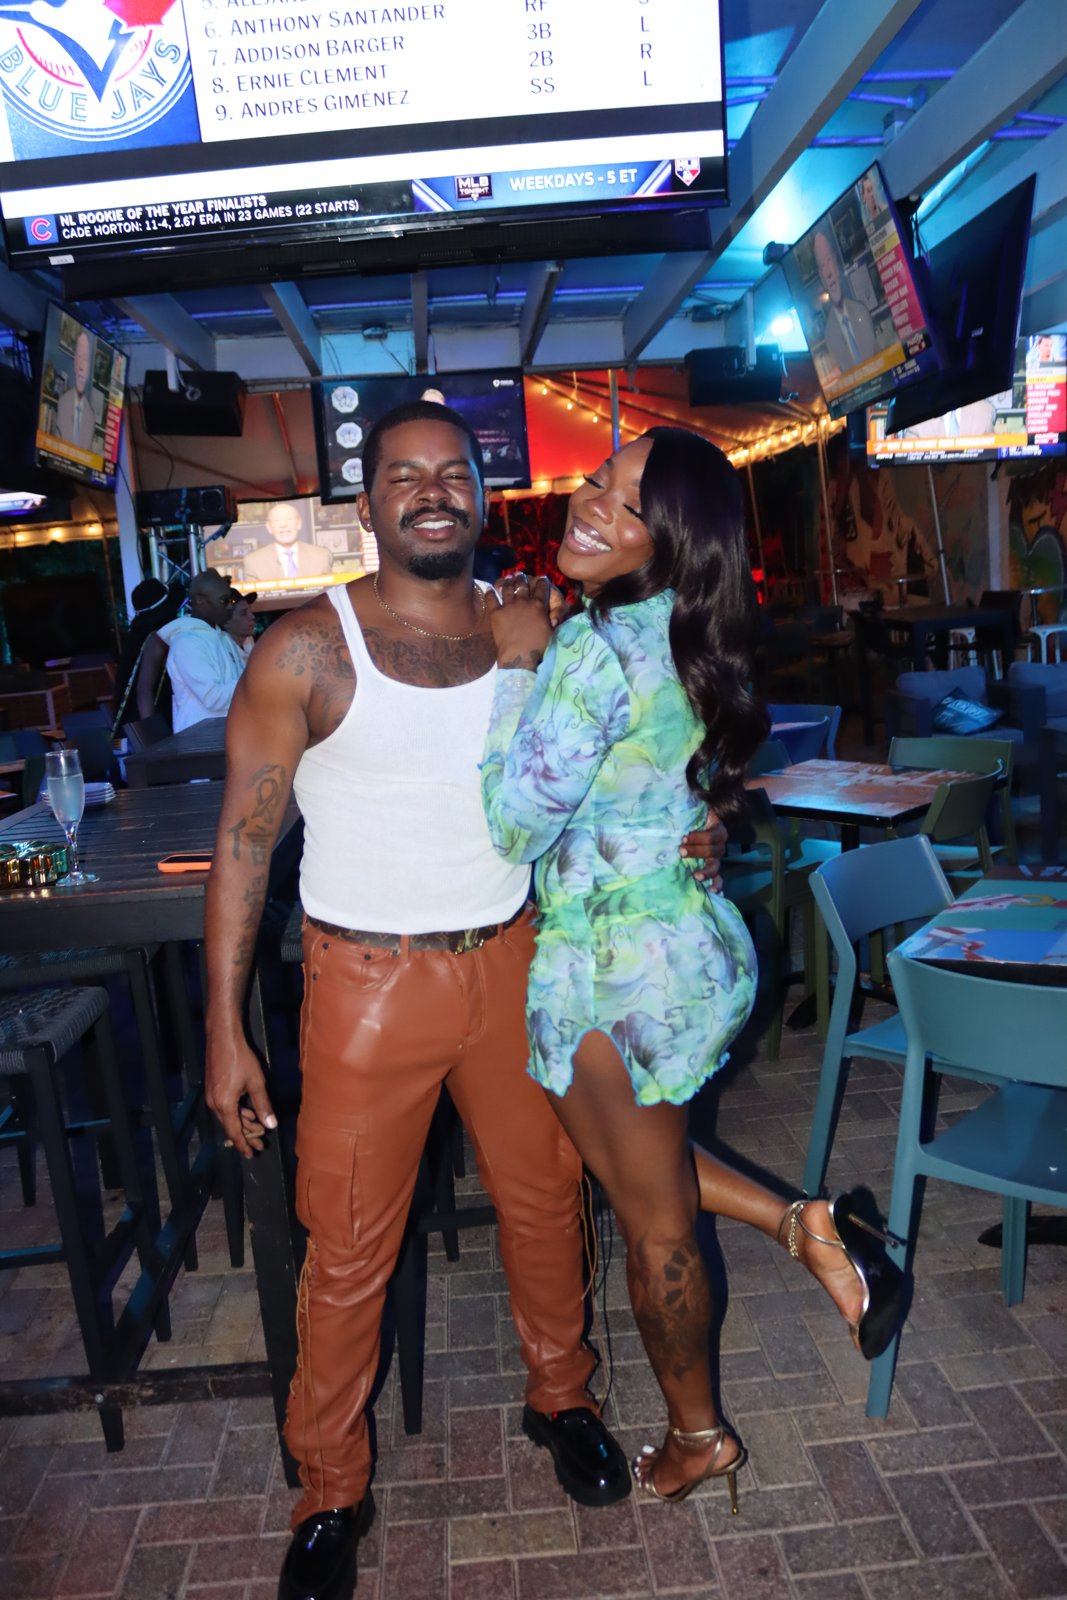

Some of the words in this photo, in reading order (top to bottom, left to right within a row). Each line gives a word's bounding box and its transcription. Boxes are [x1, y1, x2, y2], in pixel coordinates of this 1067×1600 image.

[204, 21, 222, 38] 6.
[231, 14, 322, 36] ANTHONY
[328, 4, 445, 28] SANTANDER
[208, 49, 226, 66] 7.
[234, 42, 320, 64] ADDISON
[326, 35, 404, 56] BARGER
[527, 22, 551, 40] 3B
[641, 16, 650, 32] L
[0, 44, 87, 122] BLUE
[111, 39, 181, 120] JAYS
[212, 77, 229, 94] 8.
[237, 73, 294, 92] ERNIE
[300, 64, 387, 85] CLEMENT
[529, 50, 553, 67] 2B
[641, 43, 652, 59] R
[215, 104, 233, 121] 9.
[241, 96, 318, 119] ANDRÉS
[324, 90, 410, 111] GIMÉNEZ
[531, 77, 555, 94] SS
[643, 70, 653, 86] L
[459, 176, 489, 188] MLB
[509, 171, 594, 192] WEEKDAYS
[606, 170, 616, 184] 5
[619, 169, 638, 183] ET
[59, 215, 77, 227] NL
[78, 209, 125, 225] ROOKIE
[126, 207, 143, 220] OF
[145, 204, 171, 218] THE
[171, 201, 205, 216] YEAR
[207, 195, 267, 212] FINALISTS
[62, 226, 92, 240] CADE
[94, 221, 143, 236] HORTON:
[145, 218, 172, 231] 11-4,
[173, 215, 196, 229] 2.67
[199, 213, 222, 226] ERA
[223, 211, 236, 223] IN
[238, 210, 252, 222] 23
[254, 206, 293, 220] GAMES
[295, 204, 312, 218] (22
[314, 199, 359, 214] STARTS)
